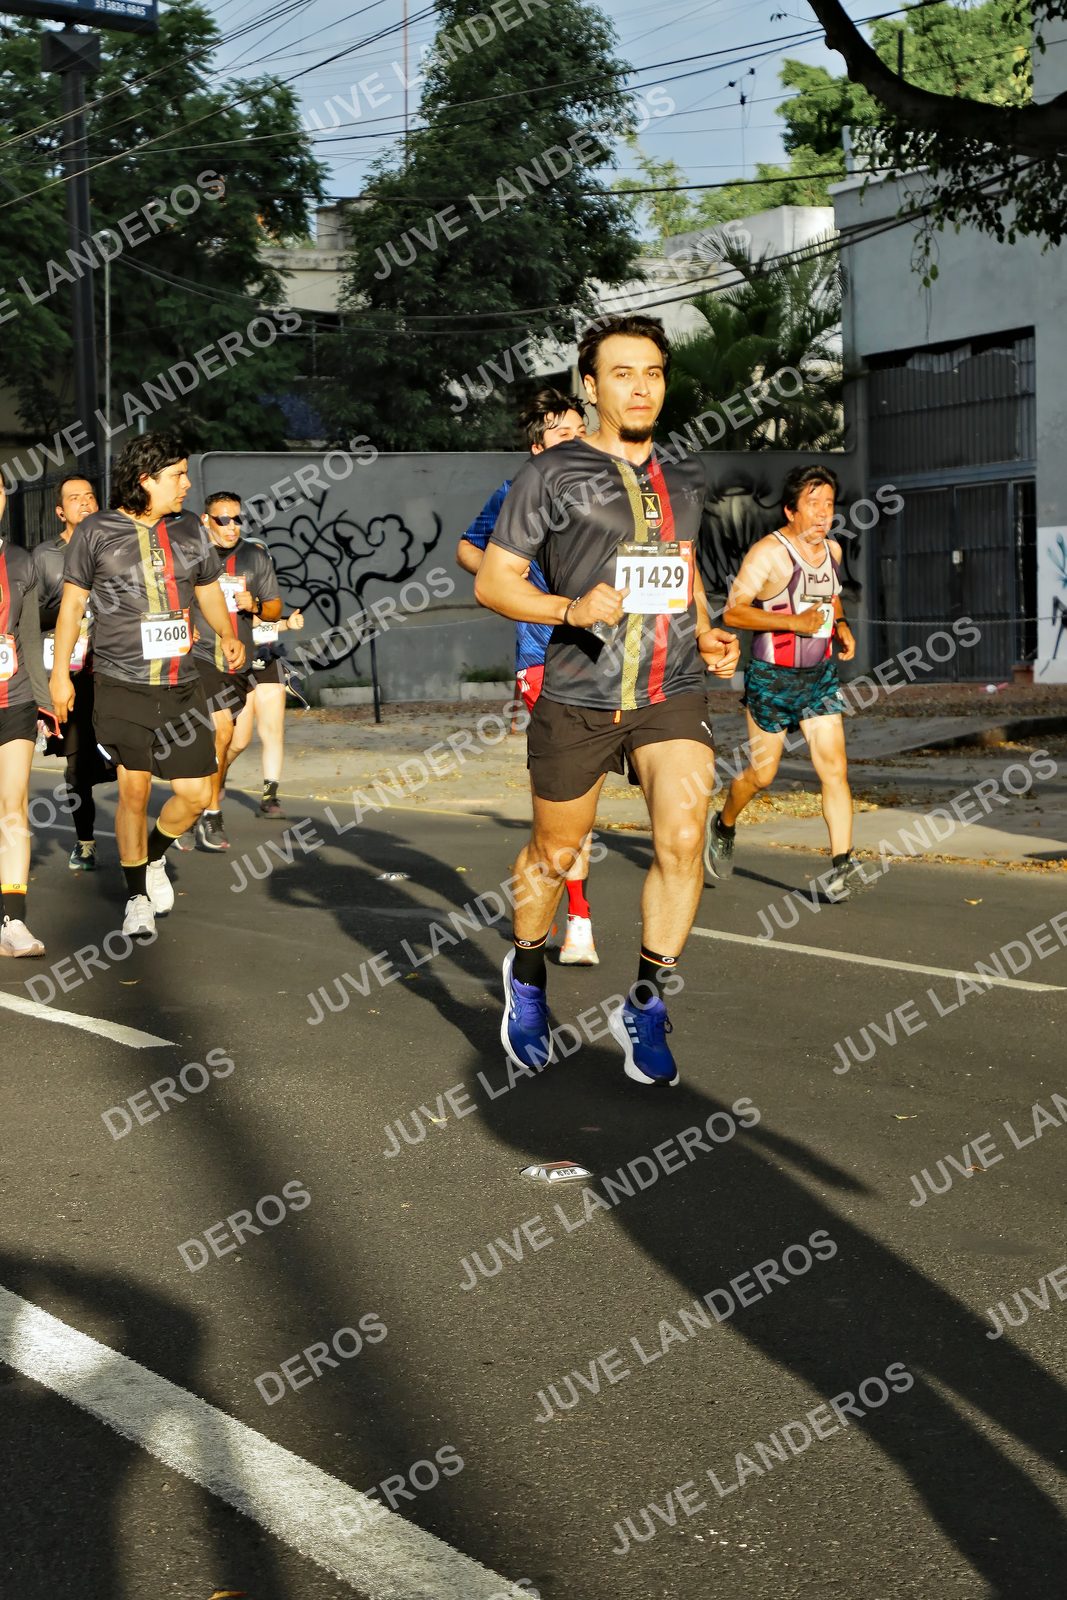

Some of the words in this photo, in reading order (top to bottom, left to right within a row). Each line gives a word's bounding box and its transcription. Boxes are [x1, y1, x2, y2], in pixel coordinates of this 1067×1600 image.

[622, 566, 684, 588] 11429
[808, 573, 830, 583] FILA
[145, 625, 187, 643] 12608
